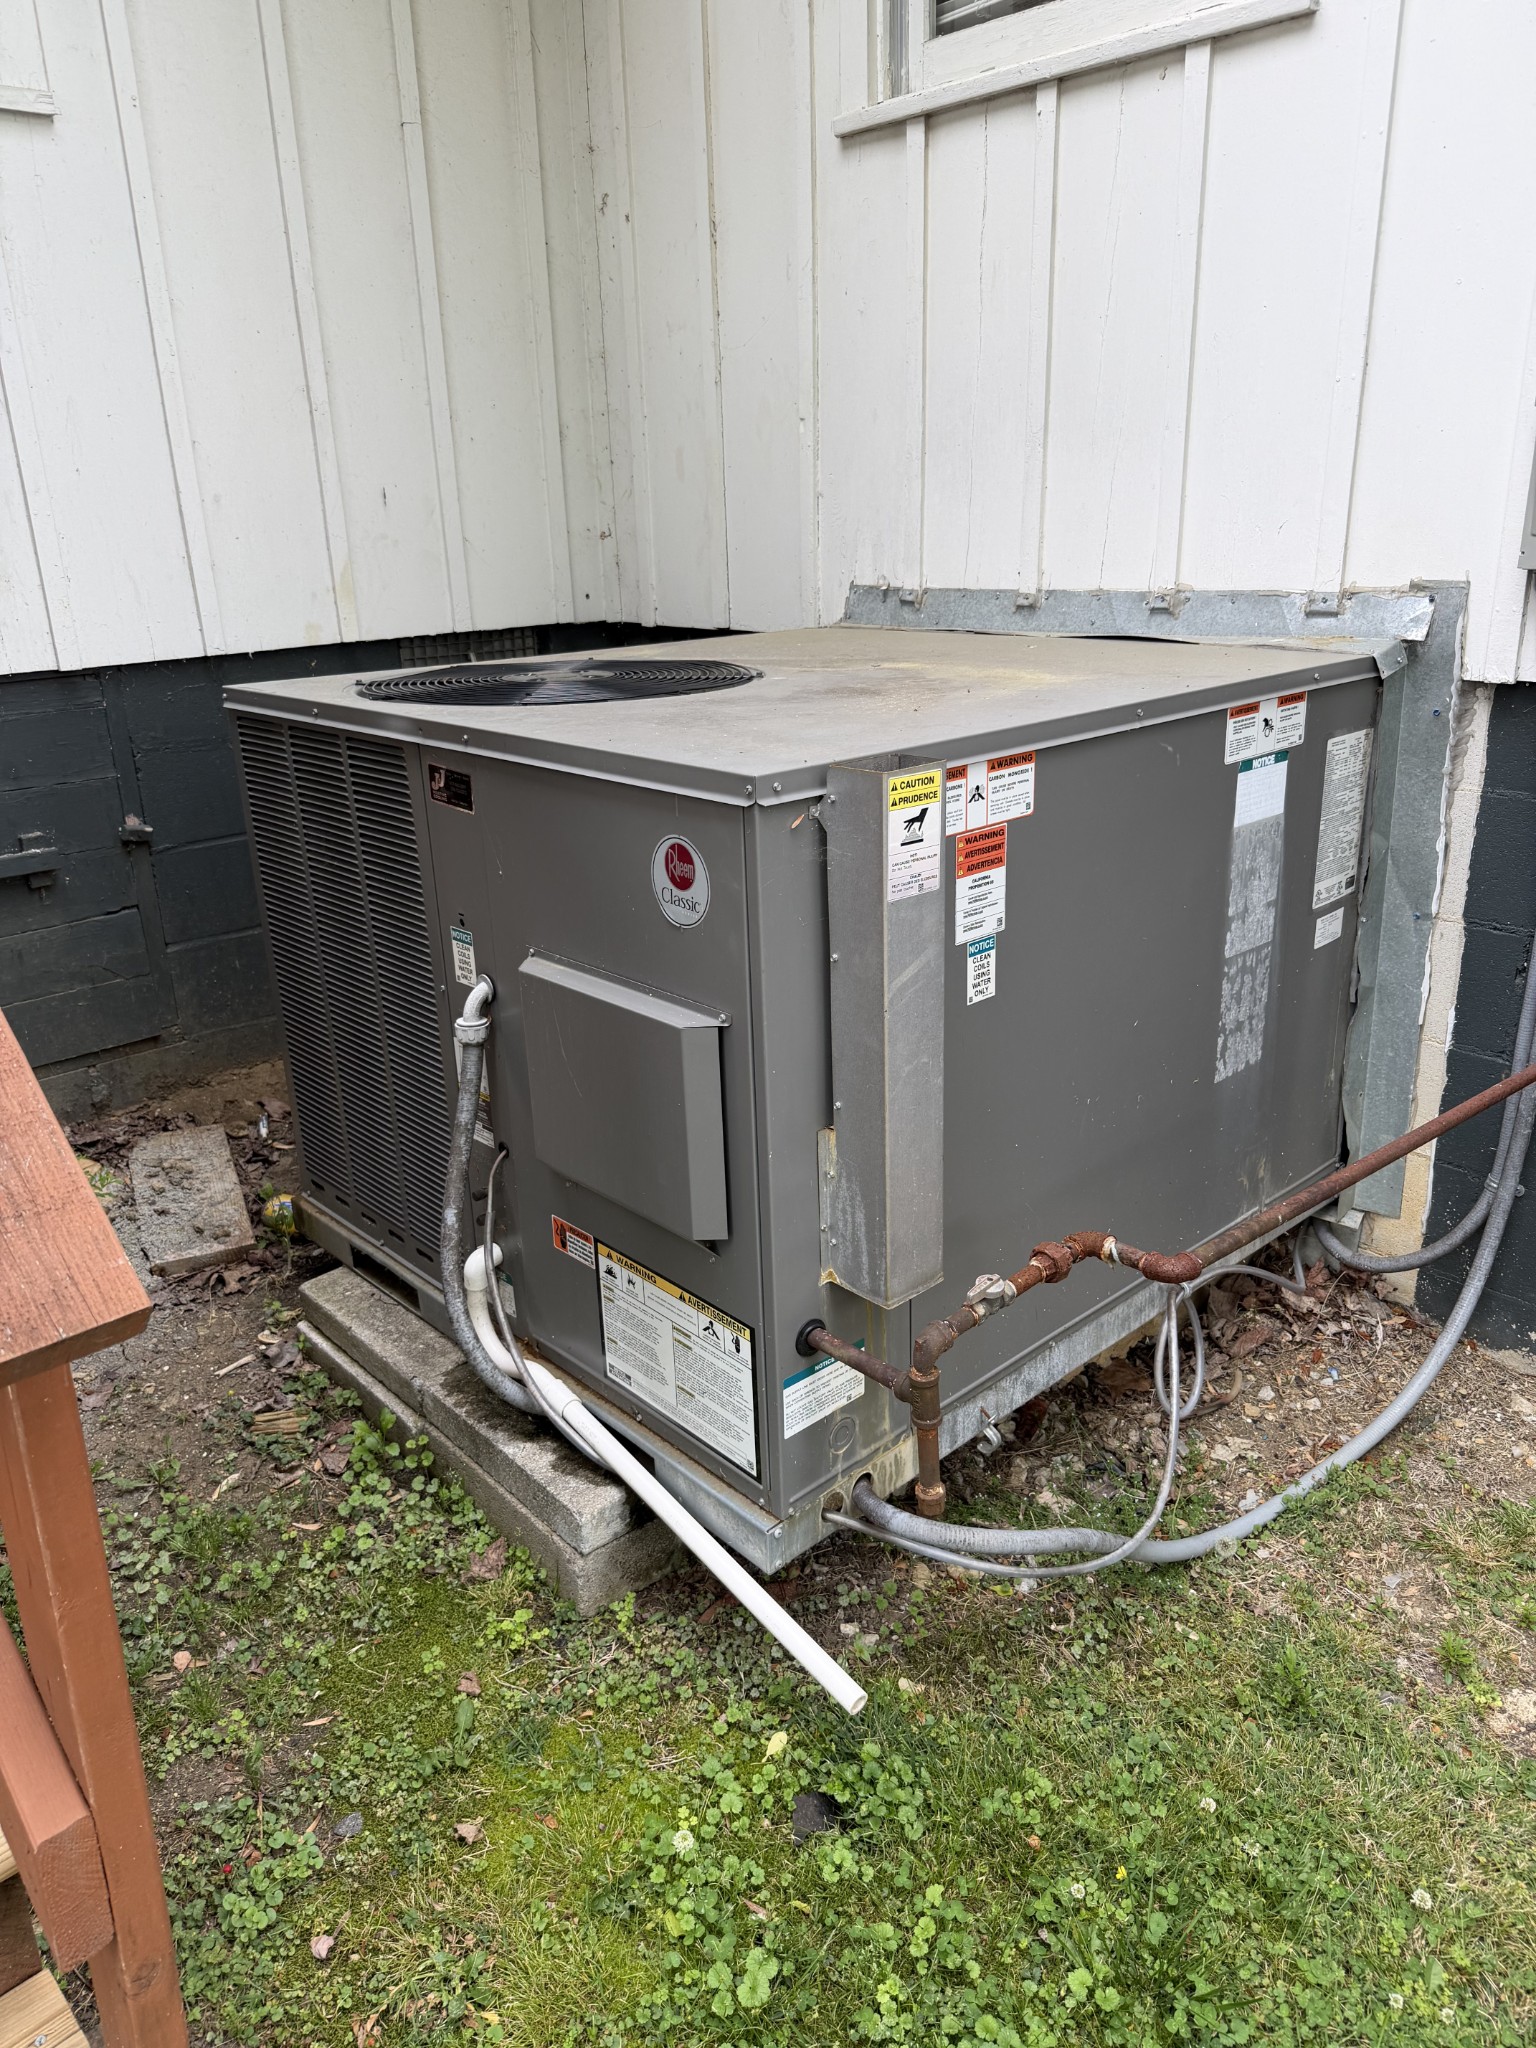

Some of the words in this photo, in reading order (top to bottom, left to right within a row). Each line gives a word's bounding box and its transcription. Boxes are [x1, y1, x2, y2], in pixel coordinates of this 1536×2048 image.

[997, 753, 1033, 769] WARNING
[1252, 754, 1276, 770] NOTICE
[900, 776, 935, 790] CAUTION
[898, 790, 938, 805] PRUDENCE
[965, 829, 1005, 845] WARNING
[964, 842, 1005, 859] AVERTISSEMENT
[668, 844, 694, 882] Rheem
[966, 856, 1003, 872] ADVERTENCIA
[661, 886, 700, 913] Classic
[453, 929, 471, 942] NOTICE
[456, 942, 470, 952] CLEAN
[970, 938, 994, 955] NOTICE
[458, 950, 470, 960] COILS
[972, 952, 991, 964] CLEAN
[458, 958, 472, 968] USING
[458, 964, 473, 975] WATER
[974, 960, 990, 972] COILS
[460, 972, 472, 982] ONLY
[974, 969, 990, 980] USING
[972, 977, 992, 990] WATER
[974, 986, 990, 997] ONLY
[616, 1254, 657, 1284] WARNING
[688, 1296, 747, 1337] AVERTISSEMENT
